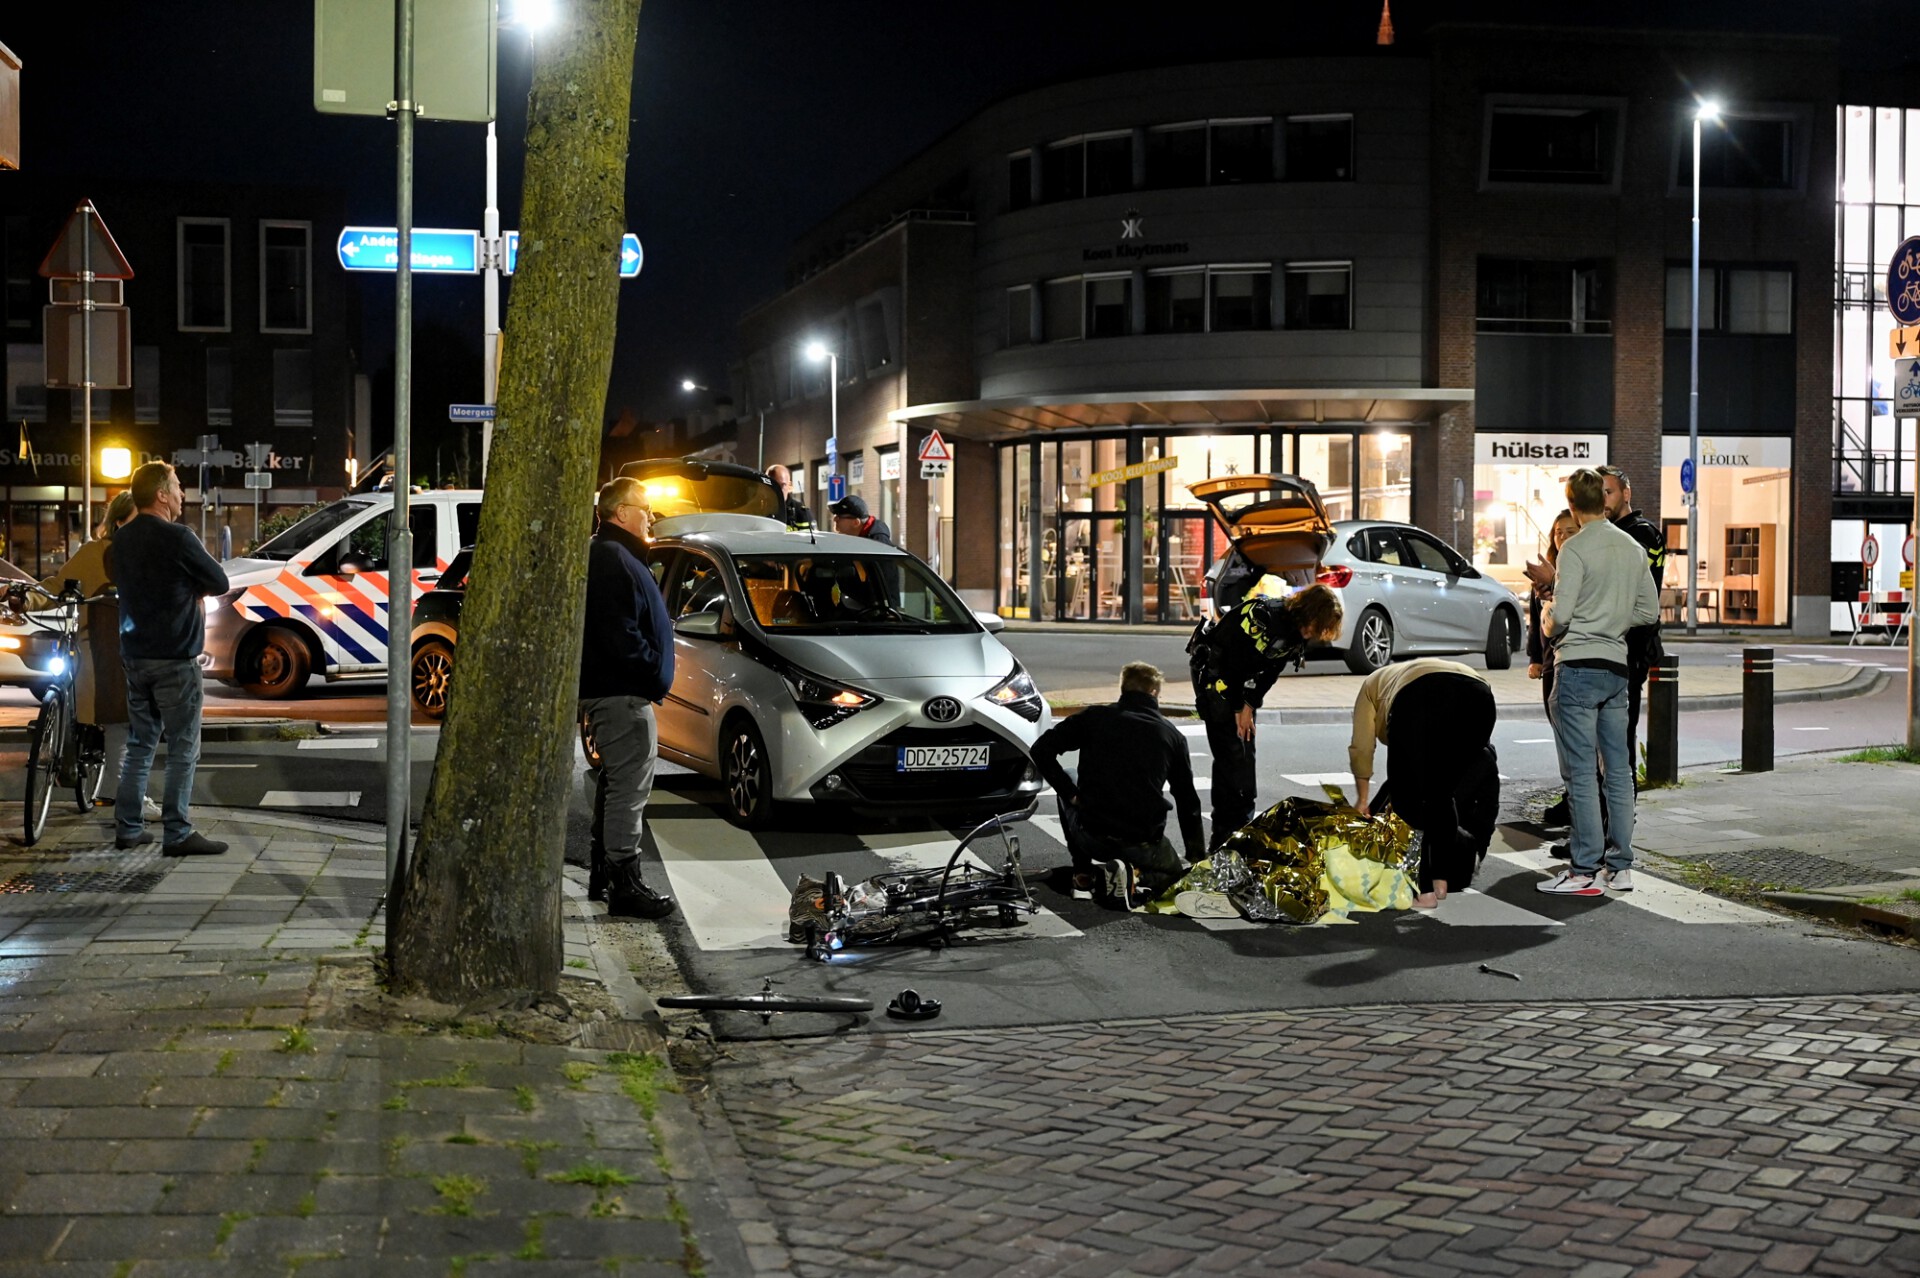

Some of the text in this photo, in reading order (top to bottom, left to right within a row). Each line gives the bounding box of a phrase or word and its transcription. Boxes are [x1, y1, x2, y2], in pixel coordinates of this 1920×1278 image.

[360, 234, 398, 246] Ander
[385, 252, 453, 267] ritingen
[1083, 242, 1189, 261] Koos Kluytmans
[1492, 441, 1568, 458] hülsta
[1702, 454, 1749, 466] LEOLUX
[1101, 470, 1123, 482] KOOS
[1126, 458, 1176, 477] KLUYTMANS
[906, 747, 988, 766] DDZ 25724
